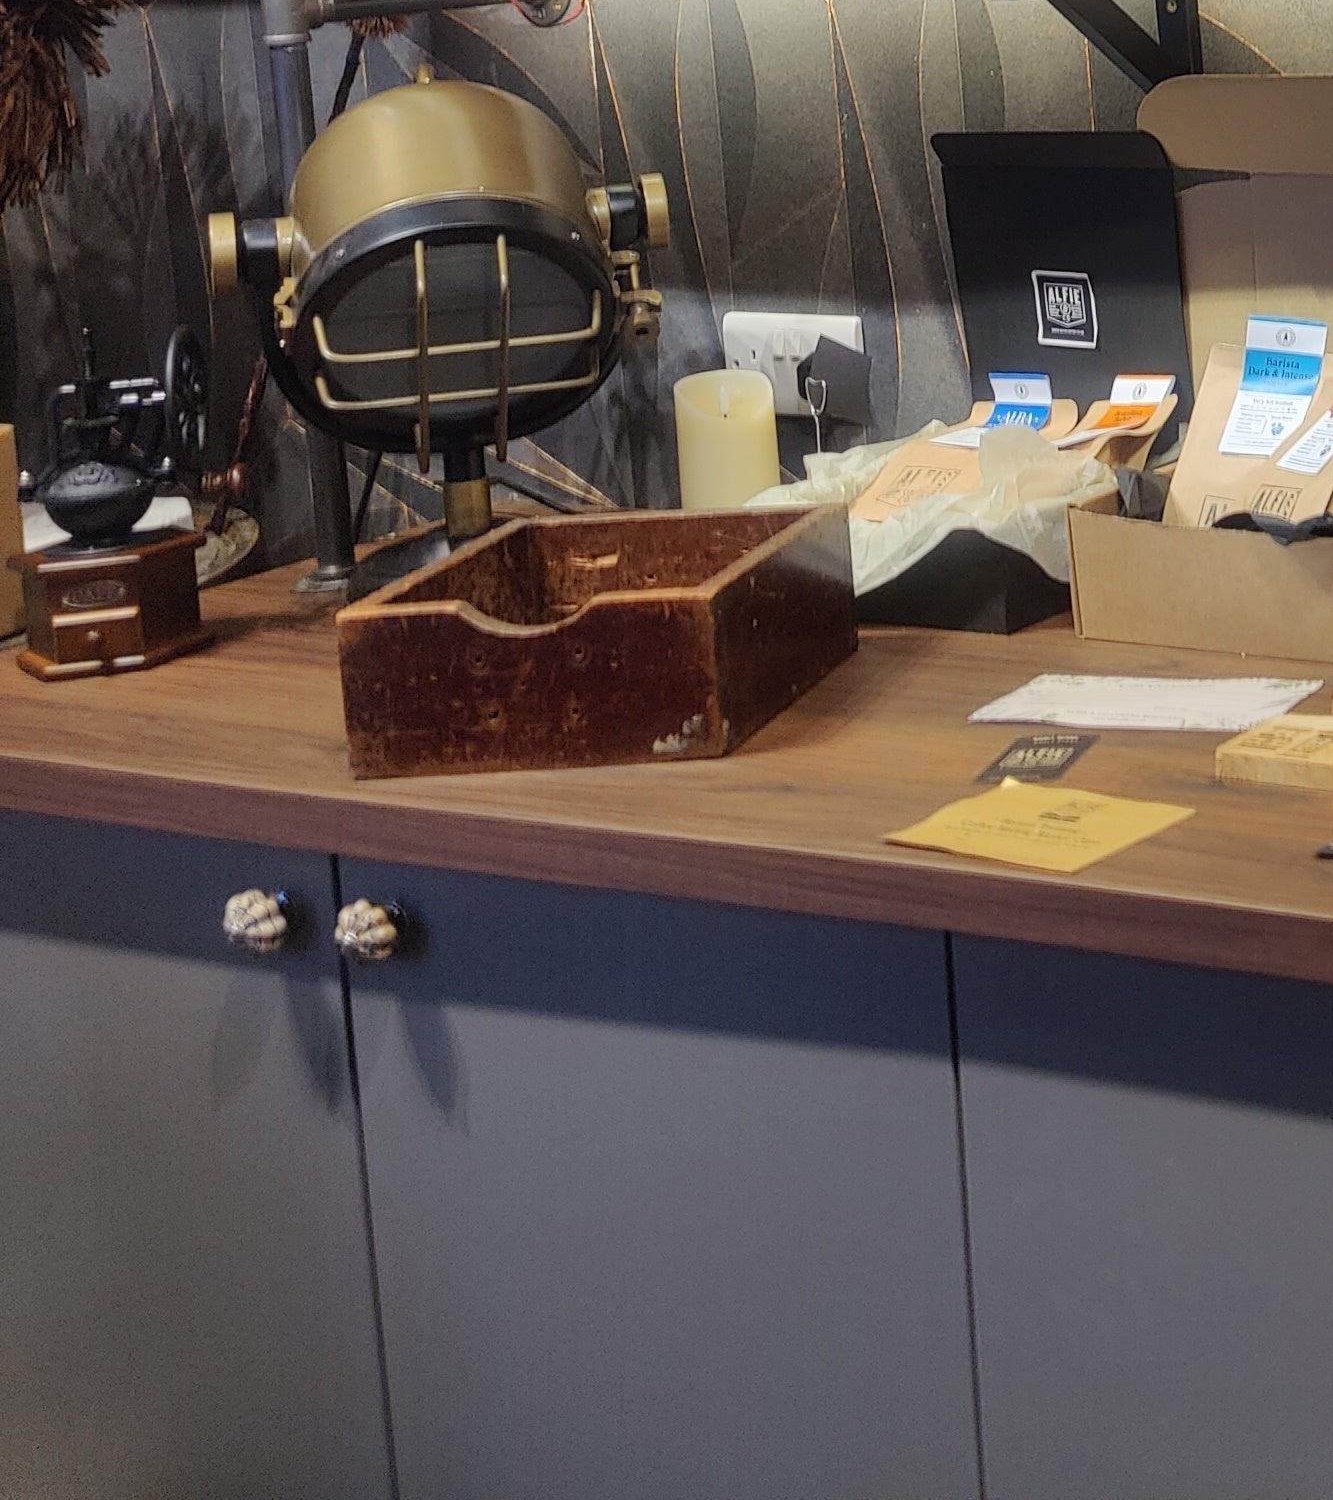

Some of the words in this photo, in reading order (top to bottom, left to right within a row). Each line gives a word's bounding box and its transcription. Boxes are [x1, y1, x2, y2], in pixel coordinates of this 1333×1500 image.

[1048, 286, 1081, 304] ALFIE
[1266, 357, 1300, 369] Barista
[1248, 368, 1270, 376] Dark
[1281, 369, 1314, 380] Intense
